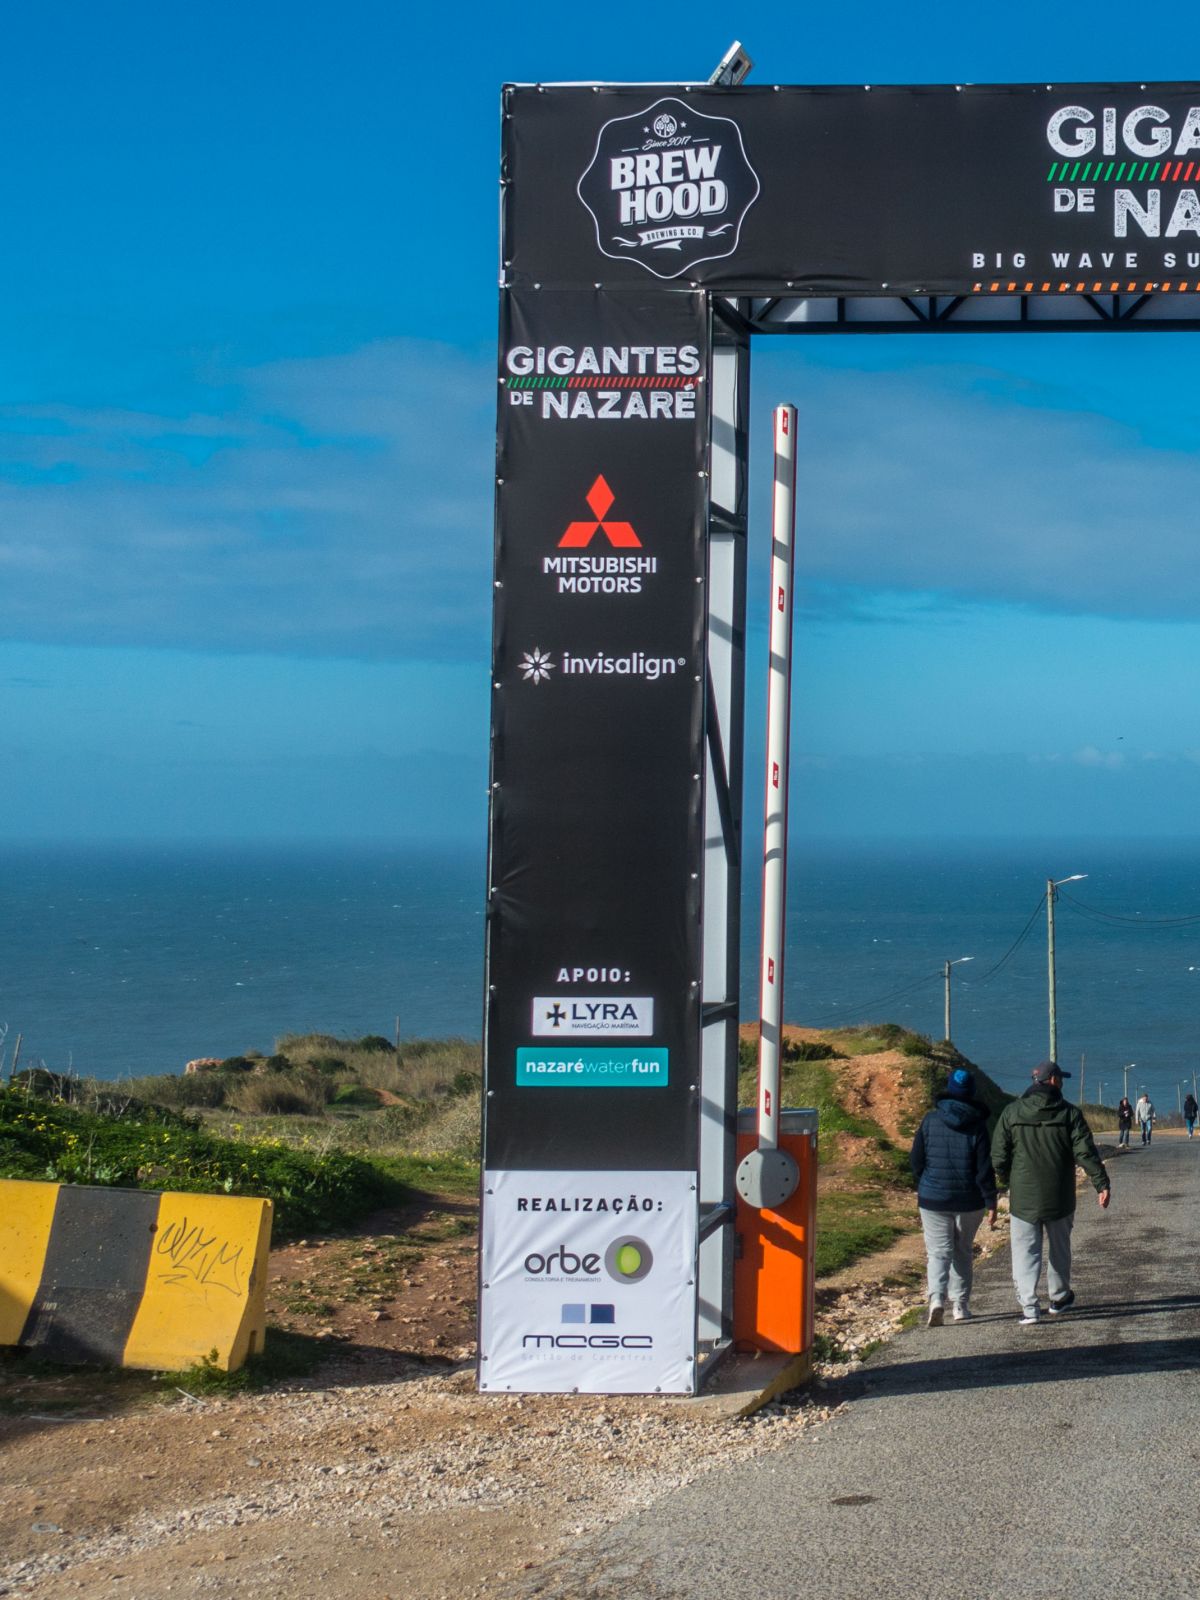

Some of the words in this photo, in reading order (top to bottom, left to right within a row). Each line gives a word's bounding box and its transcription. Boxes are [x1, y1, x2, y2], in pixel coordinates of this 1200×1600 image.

[642, 139, 668, 151] Since
[668, 136, 691, 147] 2017
[610, 145, 722, 190] BREW
[619, 179, 729, 226] HOOD
[1053, 188, 1096, 213] DE
[646, 229, 678, 241] BREWING
[688, 228, 699, 236] CO.
[973, 252, 1028, 269] BIG
[1052, 252, 1139, 269] WAVE
[506, 345, 700, 376] GIGANTES
[510, 391, 533, 405] DE
[542, 383, 696, 419] NAZARÉ
[543, 557, 657, 573] MITSUBISHI
[558, 577, 642, 593] MOTORS
[556, 967, 631, 982] APOIO:
[572, 1003, 638, 1020] LYRA
[517, 1194, 663, 1215] REALIZAÇÃO:
[524, 1245, 602, 1275] orbe
